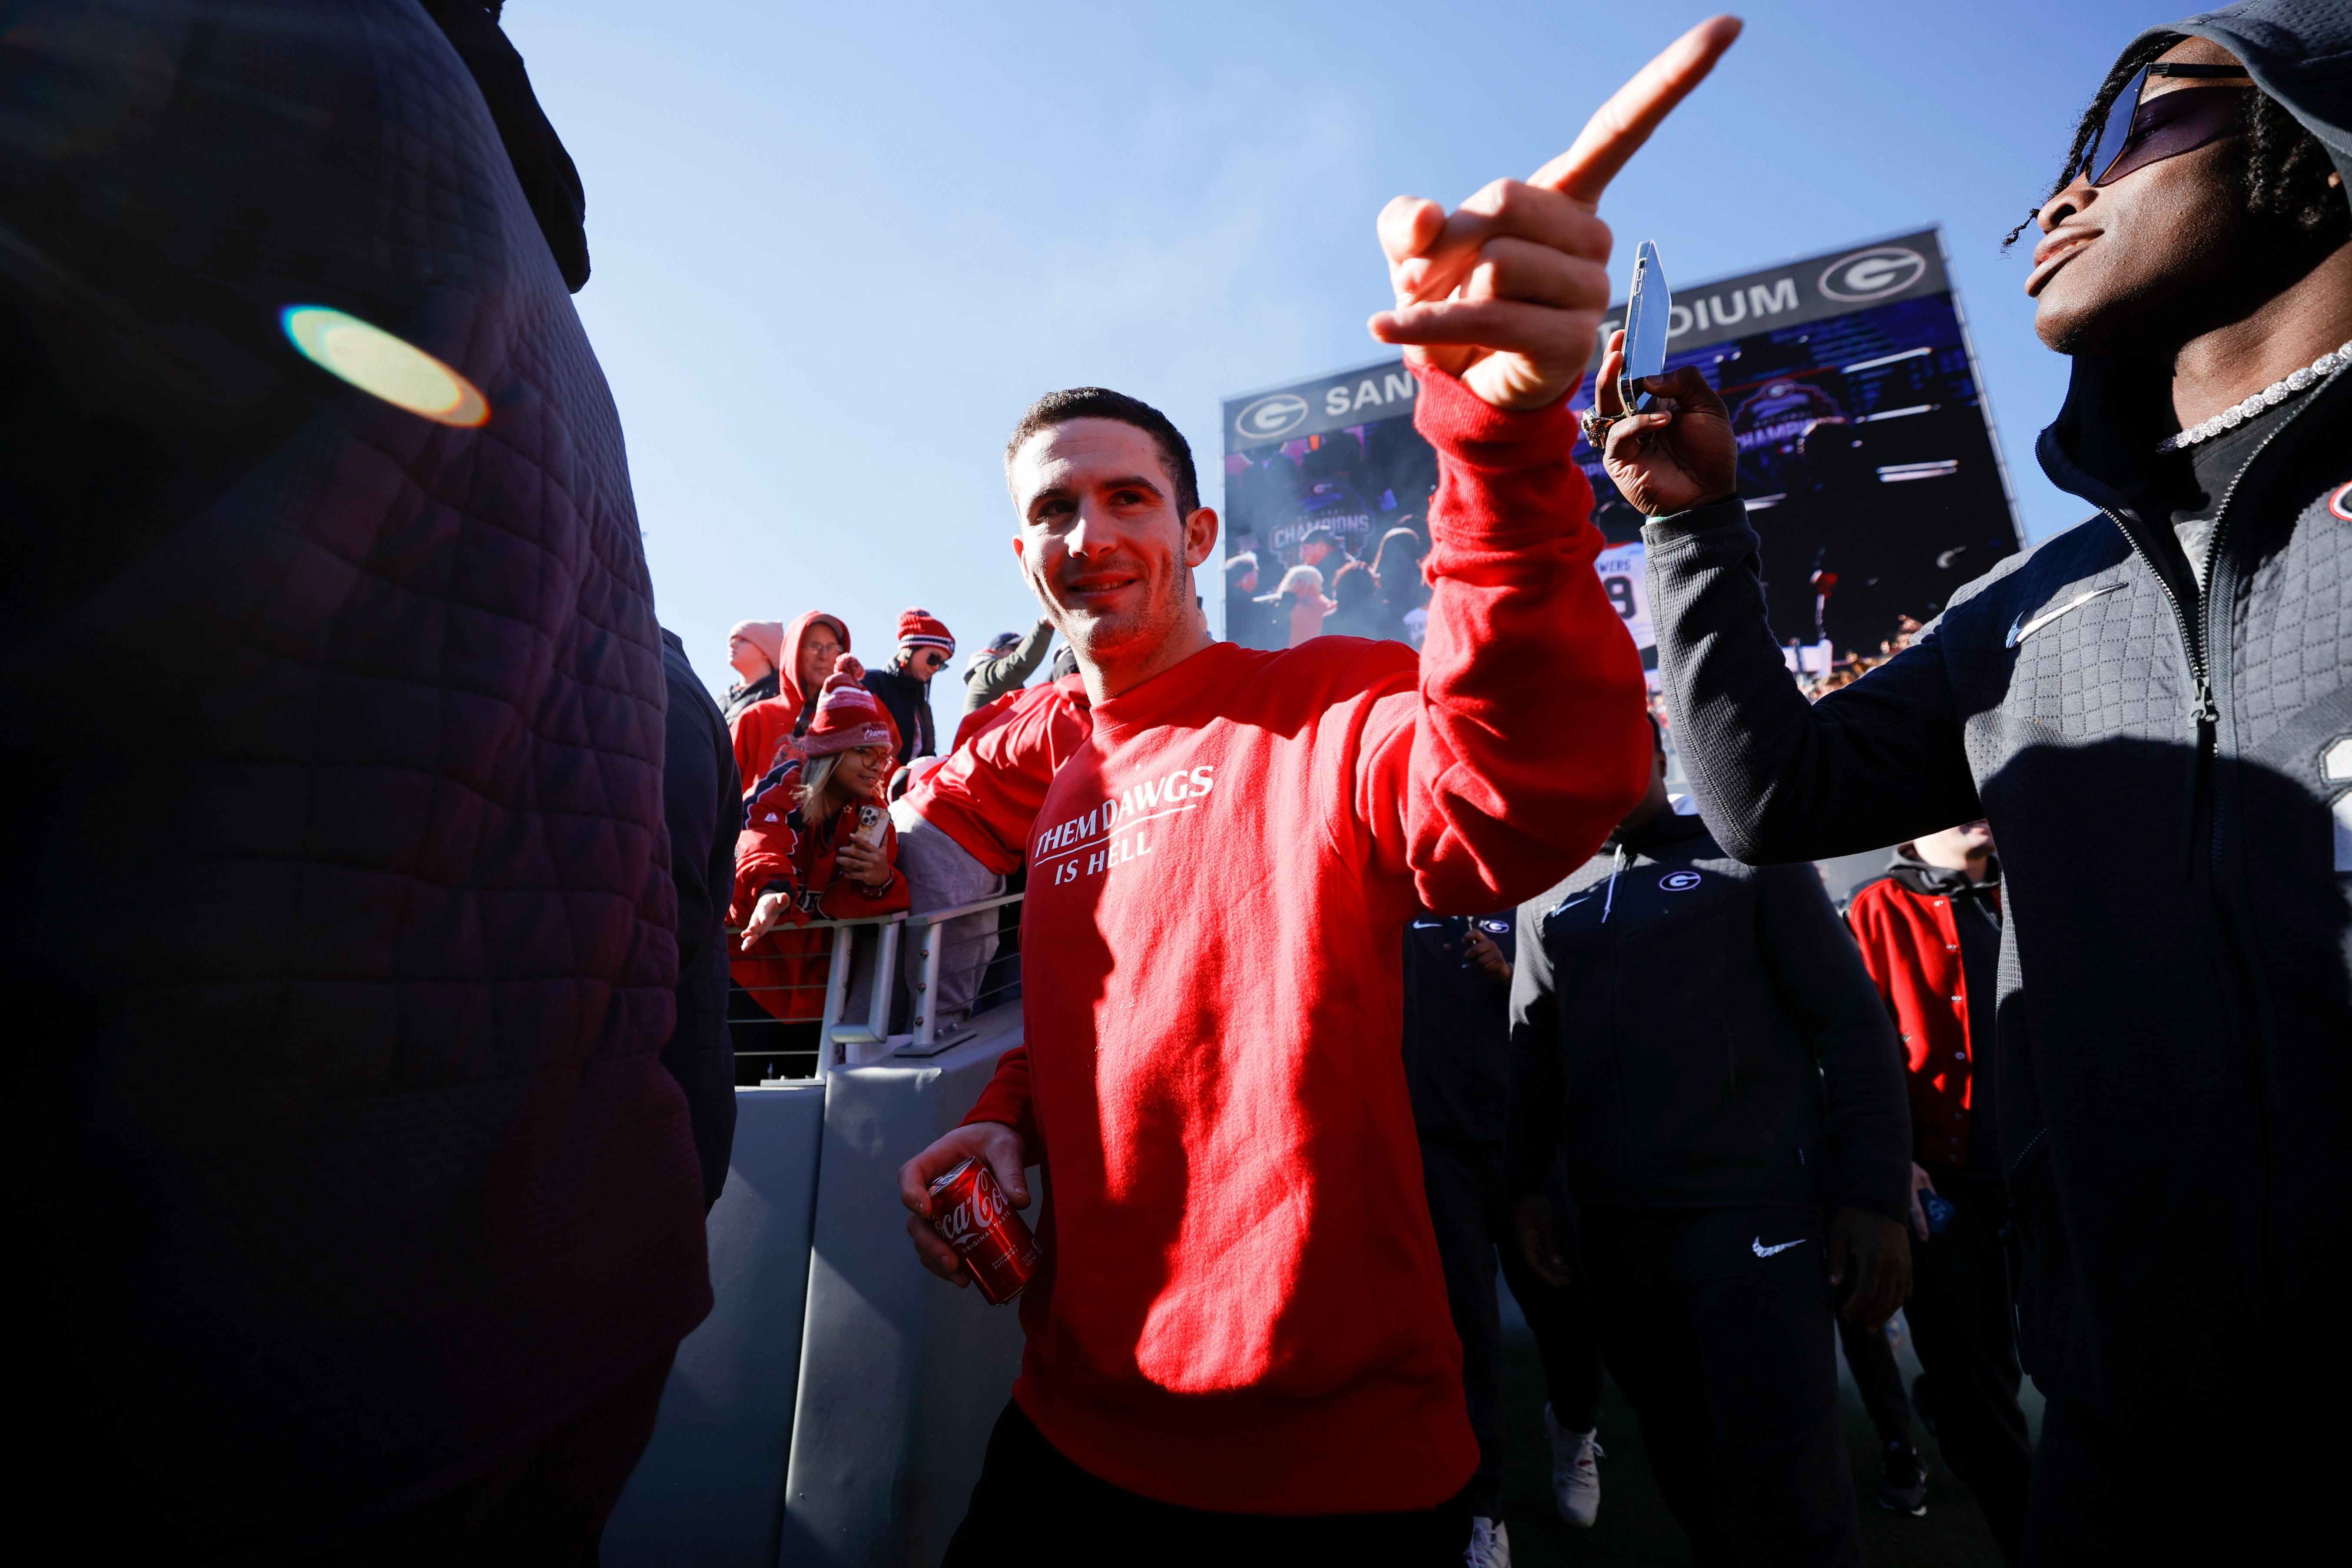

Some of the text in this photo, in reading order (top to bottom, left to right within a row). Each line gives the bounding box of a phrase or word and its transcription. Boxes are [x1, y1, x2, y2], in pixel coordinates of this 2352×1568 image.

[1325, 278, 1799, 416] SAN TDIUM
[1035, 766, 1214, 859] THEM DAWGS
[1055, 831, 1151, 885] IS HELL
[962, 1210, 1011, 1253] ORIGINAL TASTE
